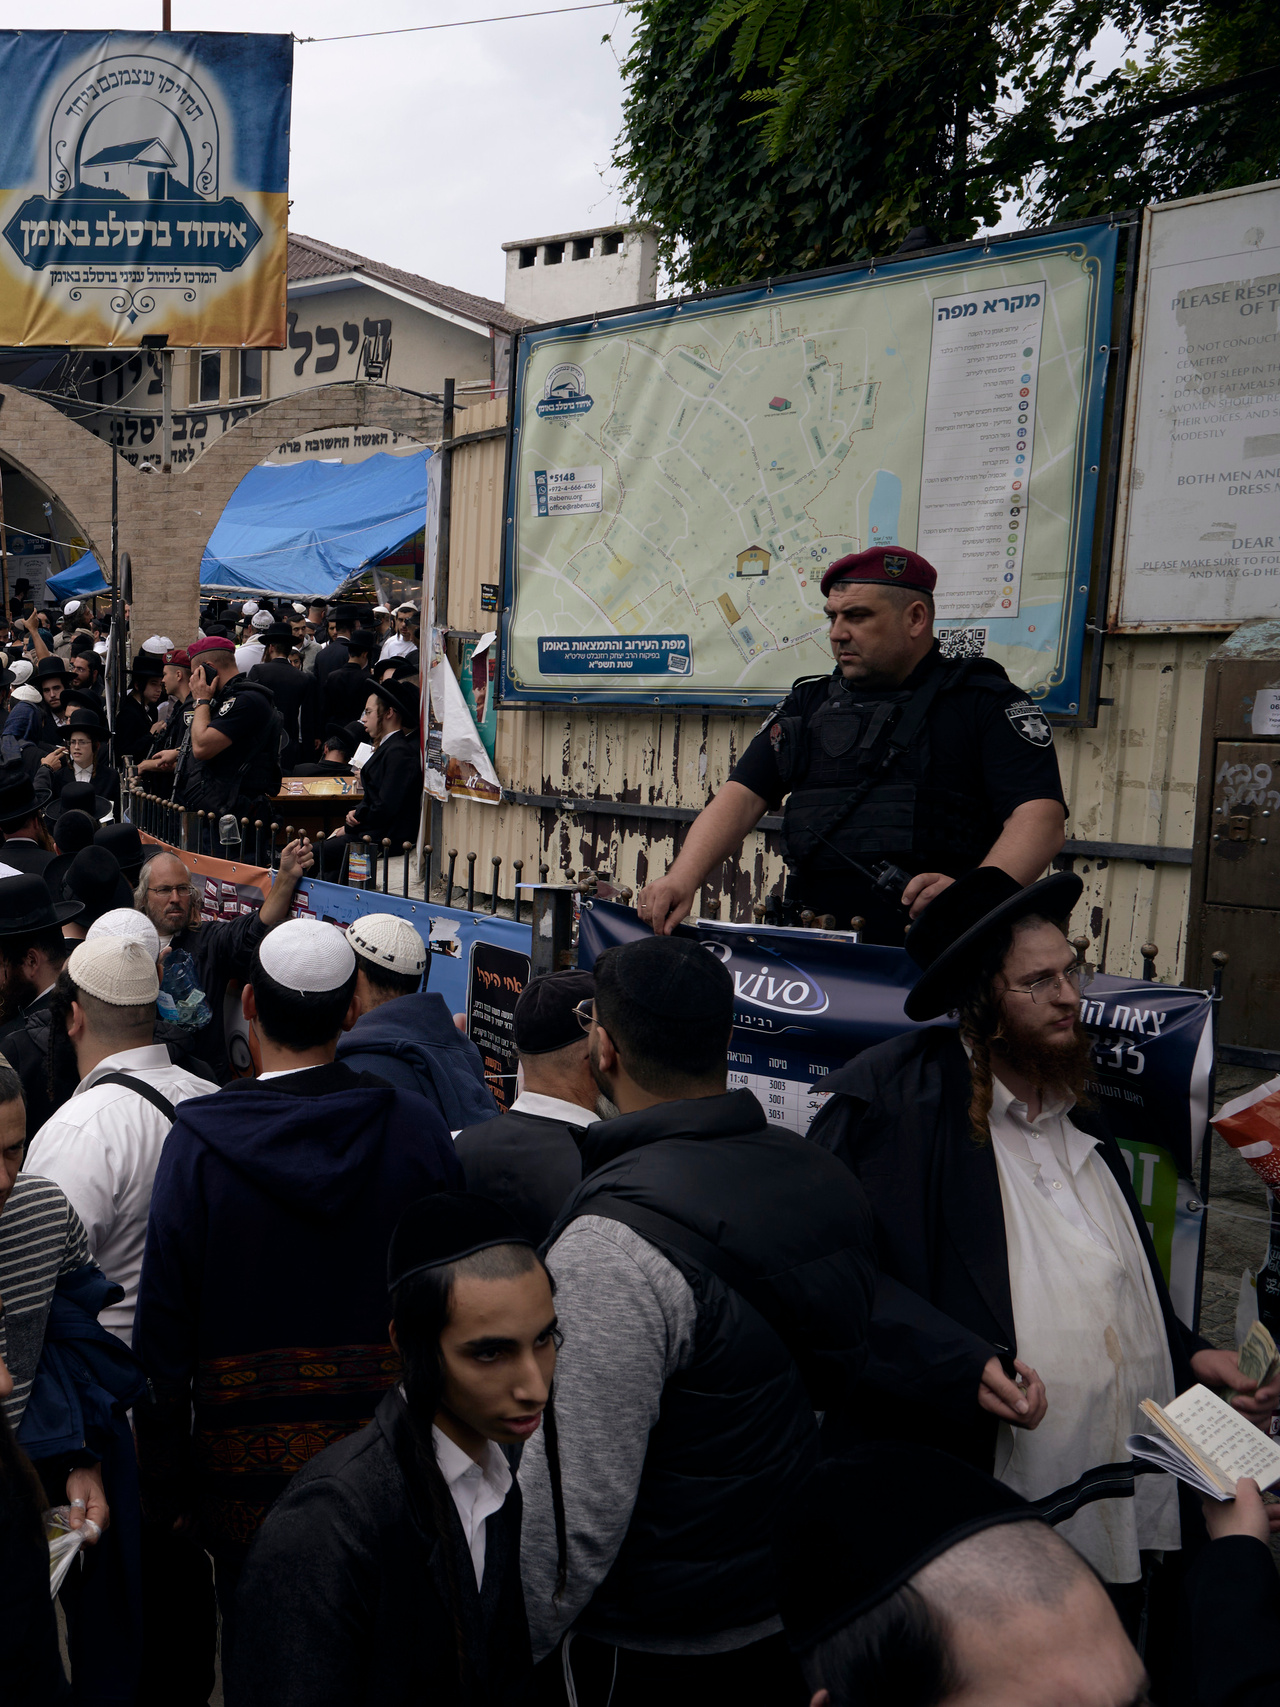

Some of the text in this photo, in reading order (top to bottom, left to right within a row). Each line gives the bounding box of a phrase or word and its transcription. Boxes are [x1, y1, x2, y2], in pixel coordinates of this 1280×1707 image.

[65, 68, 204, 122] תחזיקו עצמכם ביחד
[20, 210, 247, 257] איחוד ברסלב באומן
[50, 271, 81, 286] באומן
[83, 267, 118, 283] ברסלב
[148, 267, 181, 283] לניהול
[184, 271, 217, 284] המרכז
[1171, 283, 1280, 311] PLEASE RESP
[937, 293, 1041, 321] מקרא מפה
[1240, 302, 1264, 316] OF
[287, 310, 392, 376] היכל
[1178, 333, 1277, 355] DO NOT CONDUCT
[1176, 355, 1230, 369] CEMETERY
[1176, 374, 1192, 384] DO
[1195, 371, 1218, 381] NOT
[1220, 367, 1249, 379] SLEEP
[1252, 366, 1263, 374] IN
[1174, 379, 1275, 399] DO NOT EAT MEALS
[1173, 395, 1264, 413] WOMEN SHOULD
[1172, 417, 1201, 427] THEIR
[1245, 410, 1269, 419] AND
[1171, 429, 1226, 442] MODESTLY
[279, 434, 388, 455] האשה החשובה מרת
[1178, 470, 1252, 486] BOTH MEN
[1228, 483, 1271, 496] DRESS
[549, 494, 583, 502] Rabenu.org
[550, 502, 600, 511] office@rabenu.org
[1231, 537, 1274, 550] DEAR
[1143, 560, 1178, 569] PLEASE
[1181, 558, 1211, 568] MAKE
[1213, 557, 1240, 566] SURE
[1243, 556, 1258, 565] TO
[1189, 569, 1262, 579] AND MAY G-D
[542, 639, 686, 652] מפת העירוב והתמצאות באומן
[616, 661, 633, 669] שנת
[740, 1014, 773, 1028] רביבו
[1109, 1005, 1167, 1037] צאת
[727, 1050, 829, 1076] חברה טיסה המראה
[729, 1073, 786, 1091] 3003 11:40
[768, 1094, 785, 1105] 3001
[768, 1109, 785, 1120] 3031
